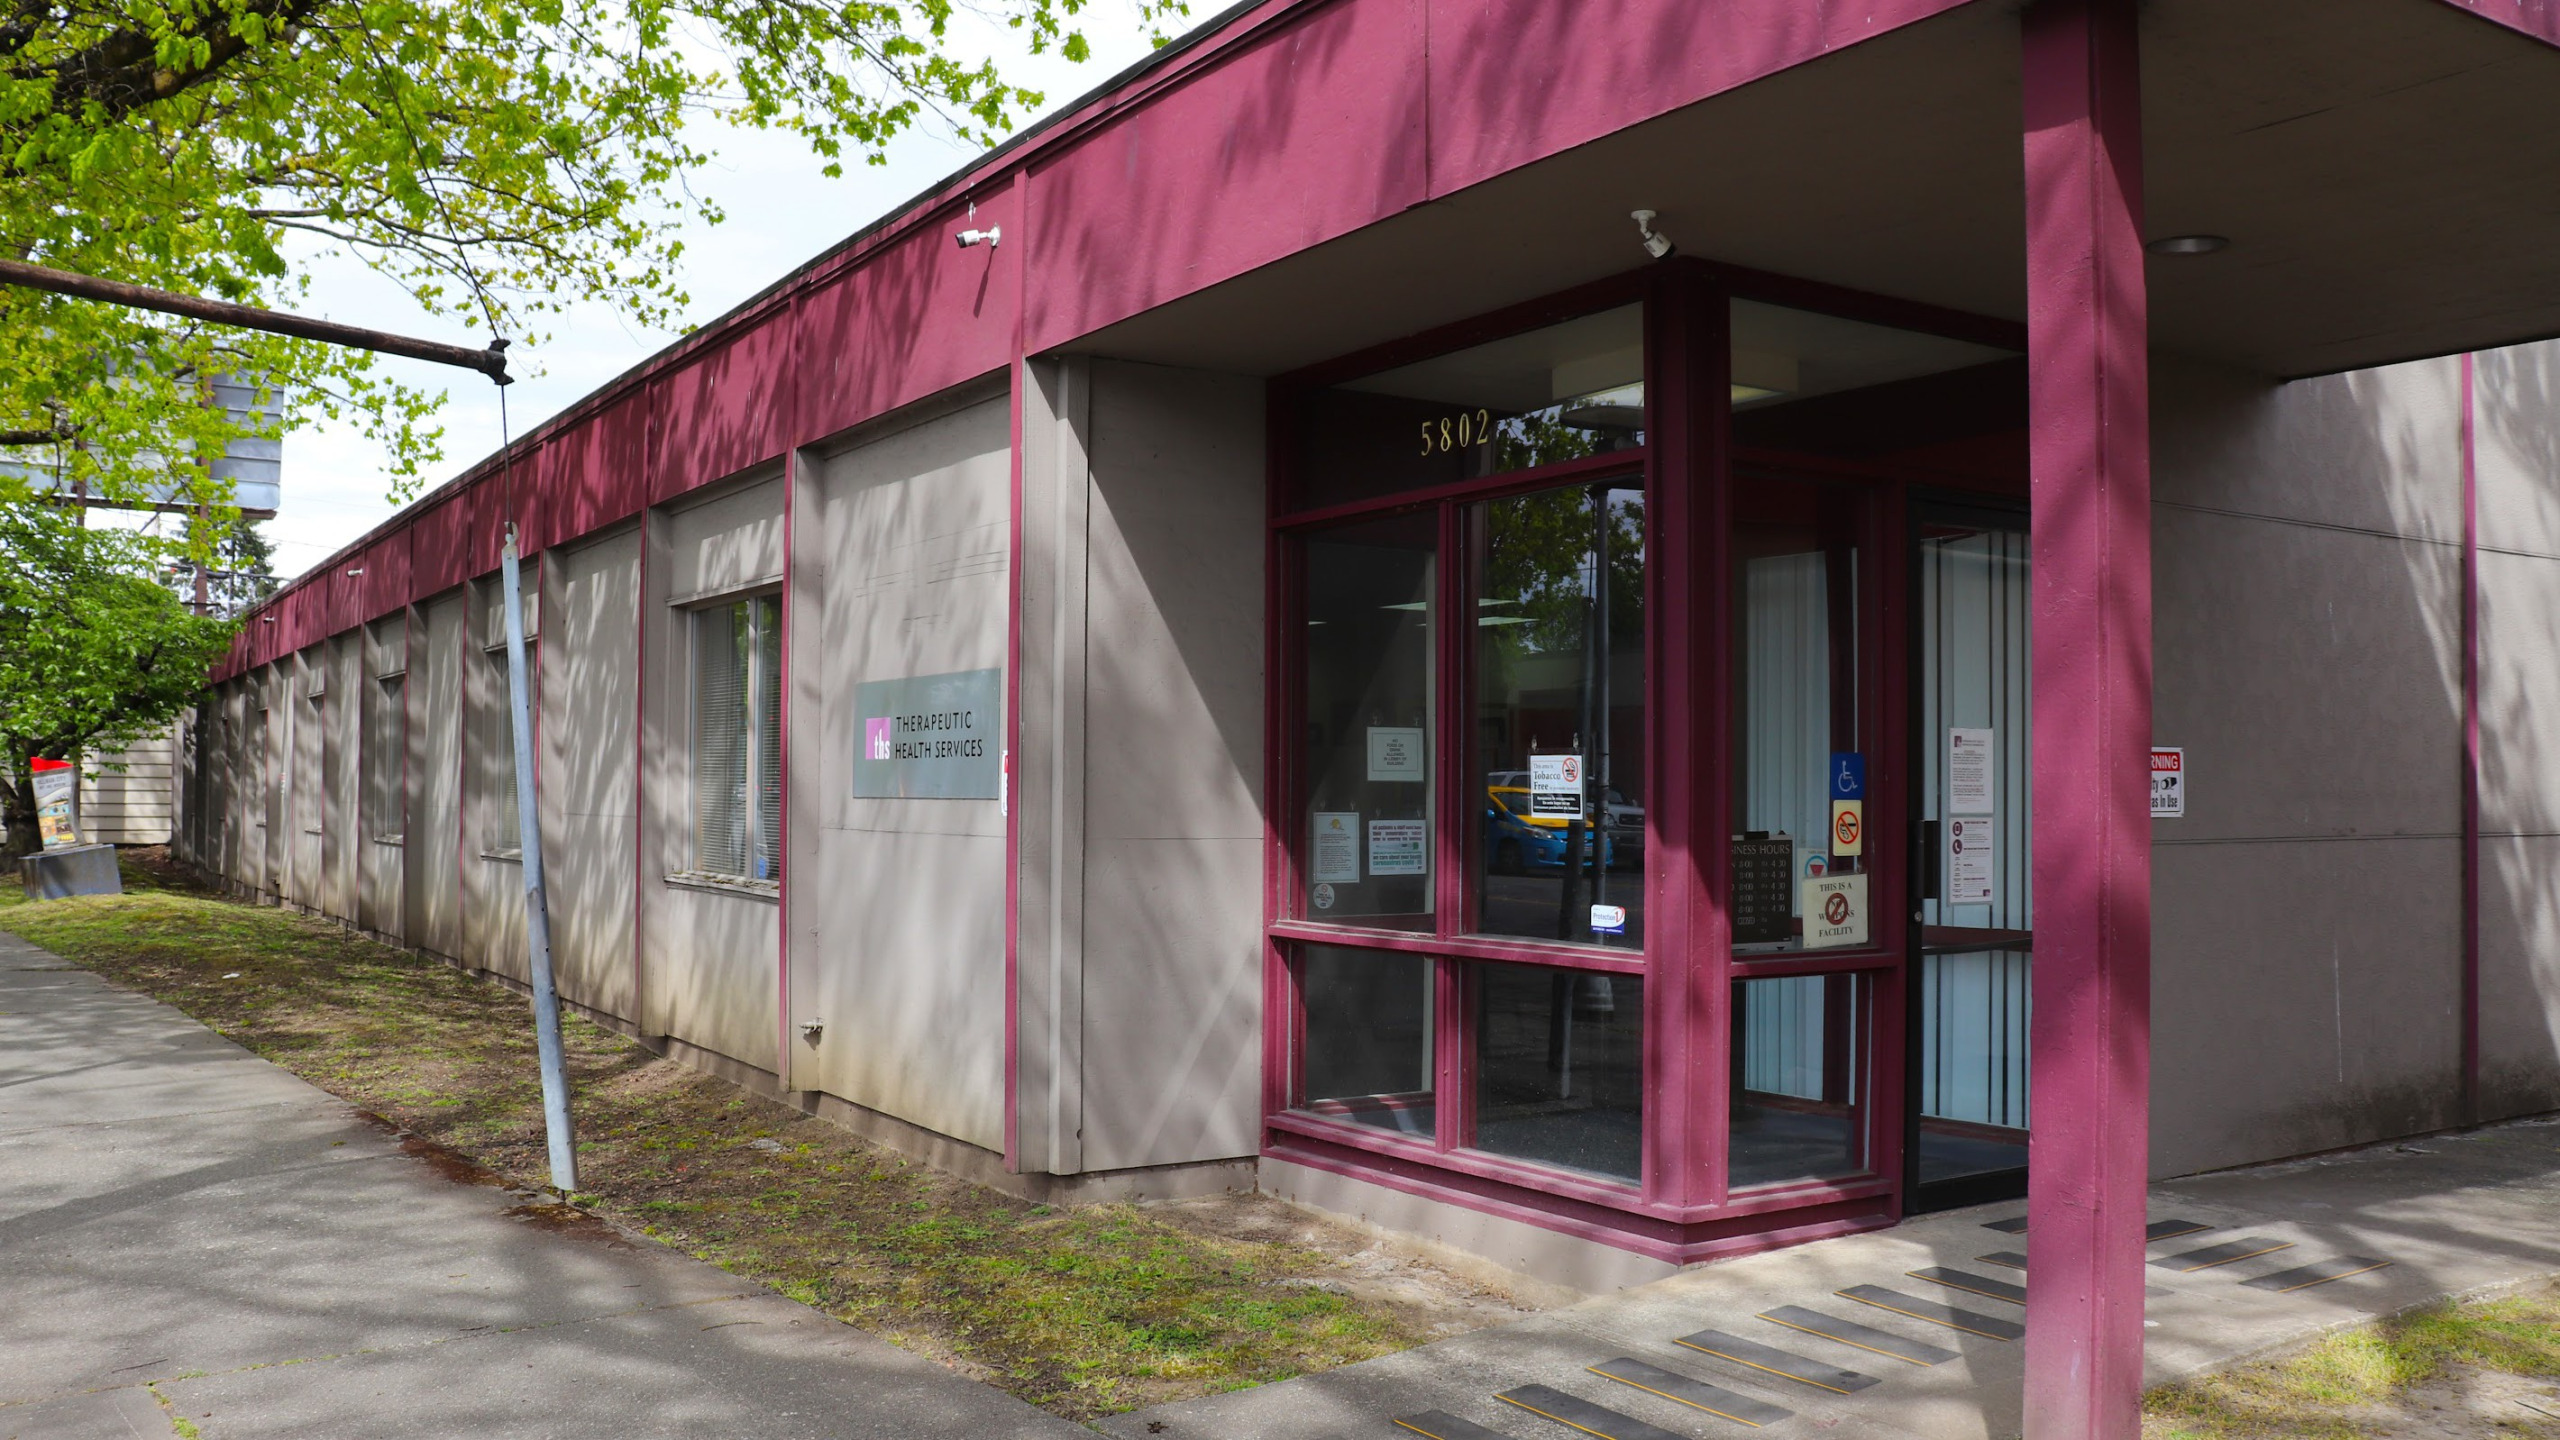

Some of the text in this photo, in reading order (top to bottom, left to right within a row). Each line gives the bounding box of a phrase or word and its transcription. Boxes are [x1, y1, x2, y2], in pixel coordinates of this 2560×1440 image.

[1420, 408, 1489, 457] 5802
[896, 710, 972, 733] THERAPEUTIC
[874, 729, 890, 760] ths
[895, 738, 983, 760] HEALTH SERVICES
[1533, 771, 1561, 780] Tobacco
[1533, 782, 1549, 790] Free
[2167, 794, 2178, 808] Use
[1760, 844, 1790, 855] HOURS
[1819, 882, 1852, 892] THIS IS A
[1819, 926, 1854, 938] FACILITY
